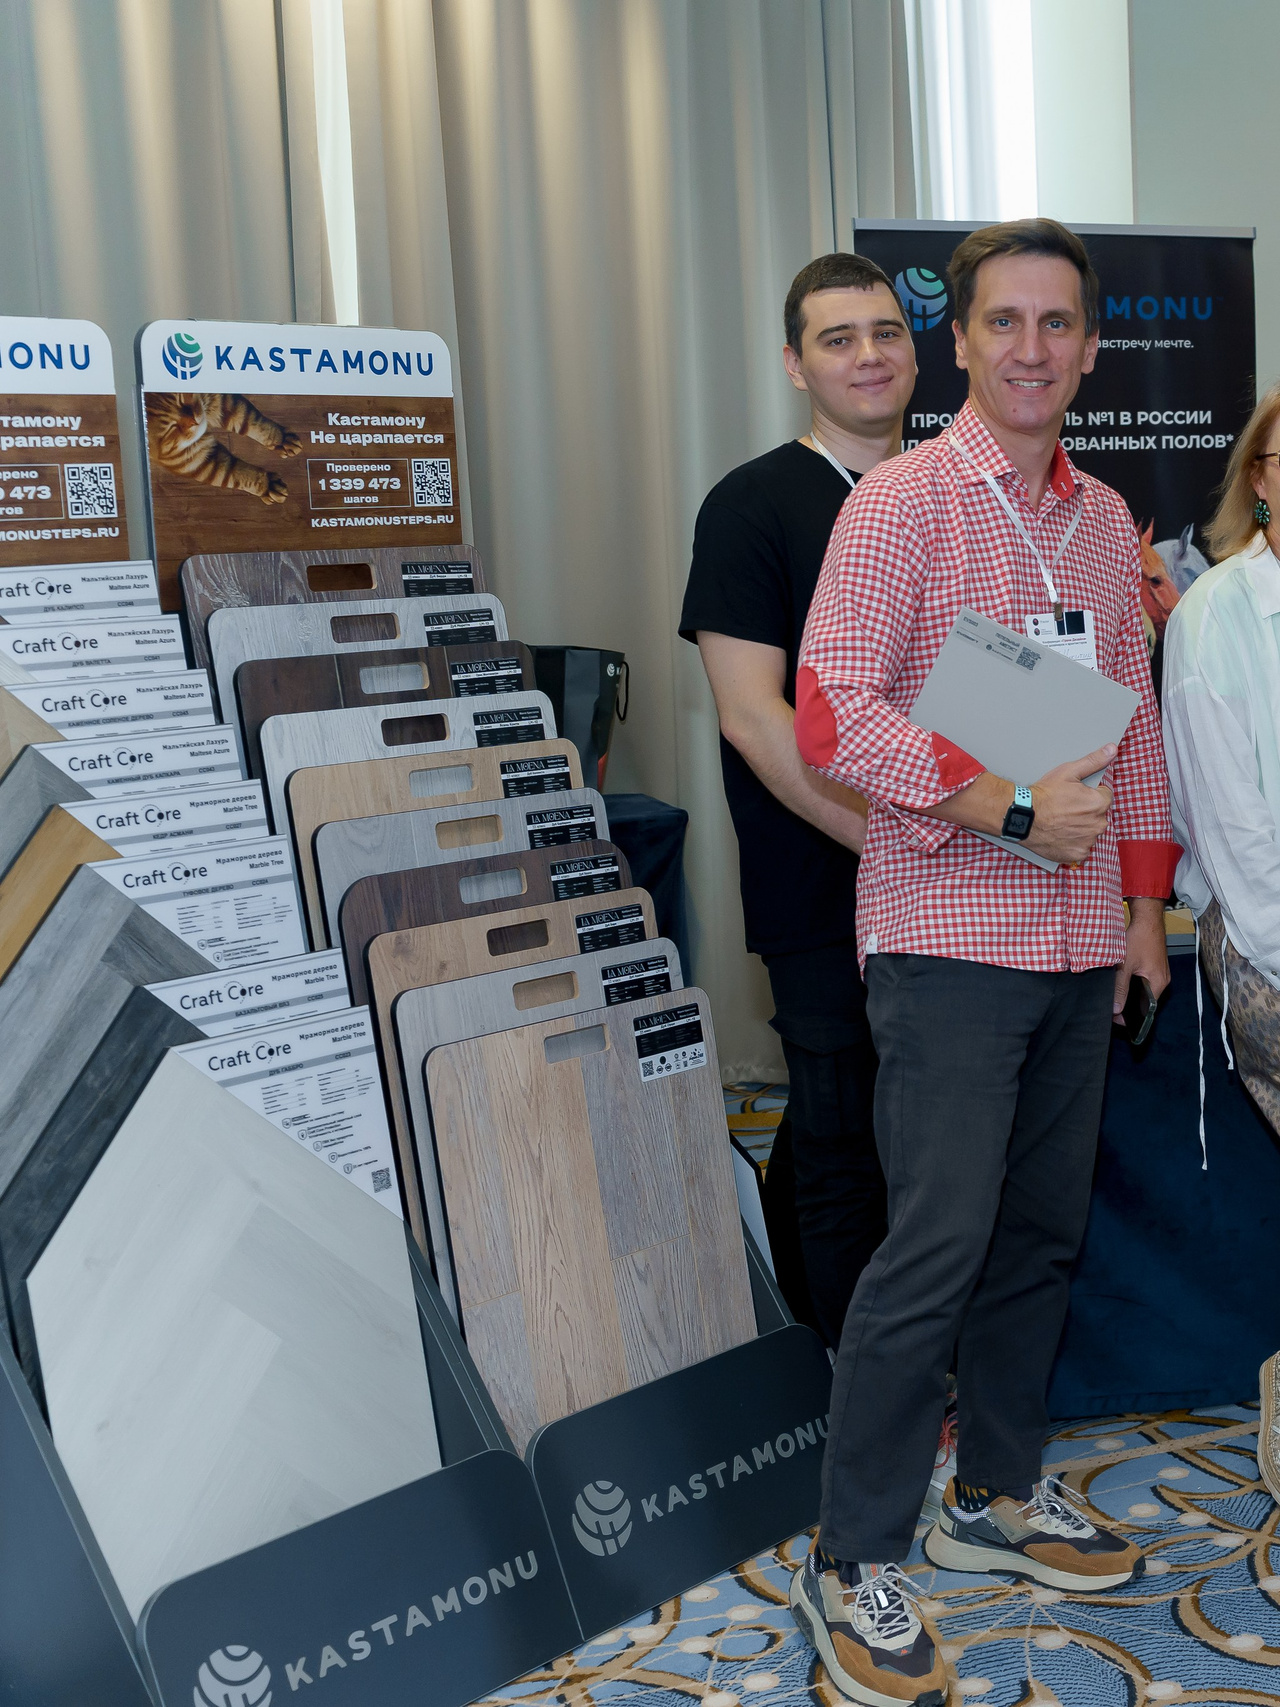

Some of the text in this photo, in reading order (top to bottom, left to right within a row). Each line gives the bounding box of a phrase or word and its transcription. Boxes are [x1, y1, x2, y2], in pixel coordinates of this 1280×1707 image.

[1097, 295, 1213, 320] MONU
[1097, 339, 1194, 351] австречу мечте.
[215, 345, 434, 377] KASTAMONU
[0, 415, 82, 430] тамону
[327, 412, 426, 430] Кастамону
[1088, 411, 1115, 426] №1
[1120, 412, 1131, 425] В
[1137, 410, 1212, 425] РОССИИ
[0, 435, 105, 451] рапается
[311, 431, 444, 447] Не царапается
[1062, 435, 1157, 451] ОВАННЫХ
[326, 463, 391, 475] Проверено
[331, 478, 365, 490] 339
[367, 478, 401, 490] 473
[10, 486, 52, 500] 473
[343, 494, 379, 505] шагов
[311, 514, 454, 529] KASTAMONUSTEPS.RU
[35, 580, 72, 597] Core
[12, 636, 98, 655] Craft Core
[41, 693, 128, 713] Craft Core
[68, 751, 154, 773] Craft Core
[189, 794, 257, 809] Мраморное дерево
[223, 805, 244, 814] Marble
[96, 808, 182, 830] Craft Core
[216, 849, 283, 865] Мраморное дерево
[249, 859, 284, 870] Marble Tree
[123, 865, 208, 889] Craft Core
[271, 963, 338, 982] Мраморное дерево
[304, 973, 339, 985] Marble Tree
[179, 984, 264, 1010] Craft Core
[299, 1021, 365, 1041] Мраморное дерево
[331, 1030, 366, 1043] Marble Tree
[208, 1043, 292, 1072] Craft Core
[641, 1413, 830, 1522] KASTAMONU
[285, 1550, 540, 1692] KASTAMONU
